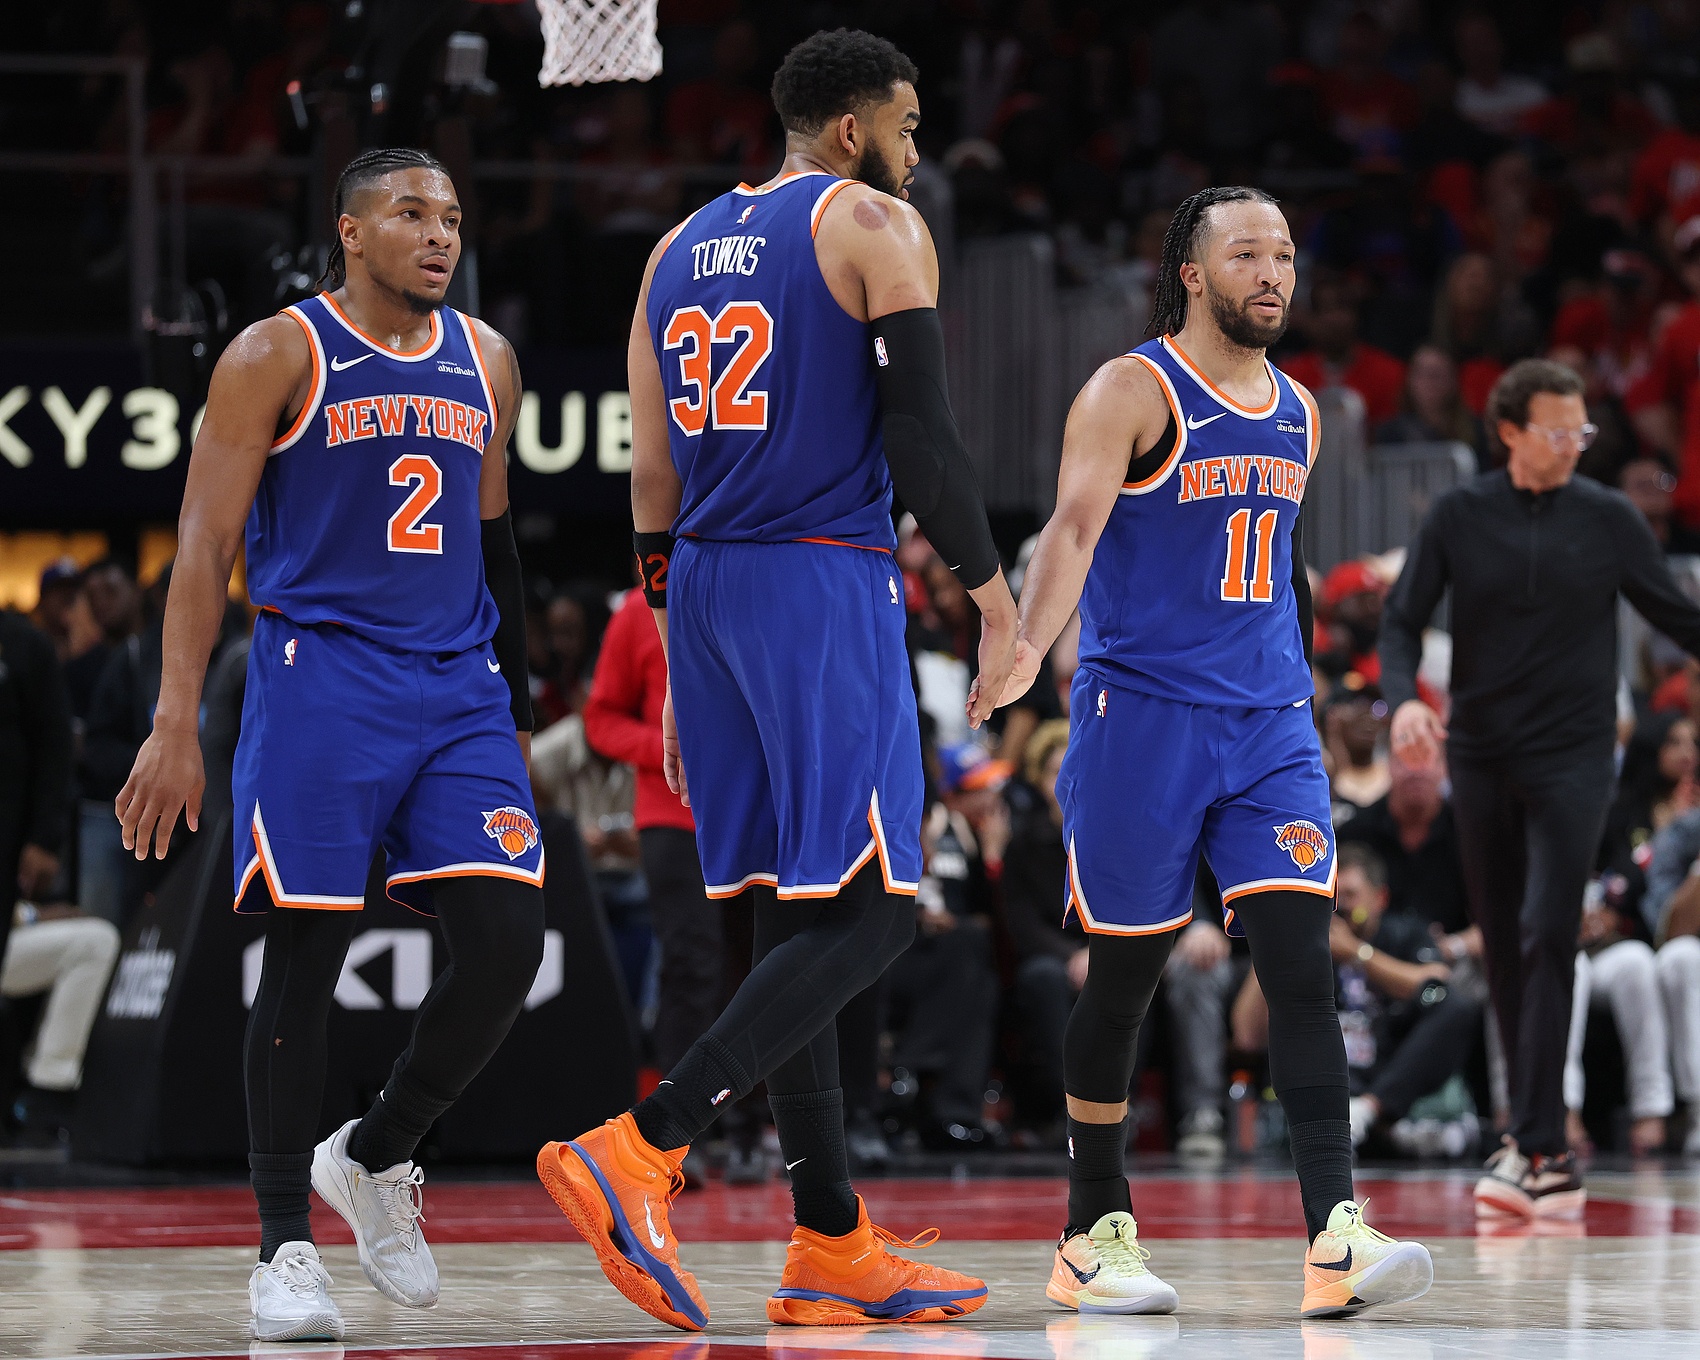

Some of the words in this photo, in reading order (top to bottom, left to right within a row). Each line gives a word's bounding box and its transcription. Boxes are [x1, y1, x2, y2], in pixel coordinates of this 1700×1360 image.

[691, 236, 766, 281] TOWNS
[437, 365, 453, 373] abu
[454, 366, 476, 377] dhabi
[663, 301, 774, 437] 32
[0, 385, 207, 471] KY3
[506, 390, 633, 474] UB
[324, 394, 408, 449] NEW
[409, 394, 488, 456] YORK
[1178, 455, 1253, 504] NEW
[388, 454, 443, 555] 2
[636, 552, 669, 591] 2
[1220, 508, 1279, 602] 11
[487, 811, 536, 842] KNICKS
[1278, 825, 1326, 855] KNICKS
